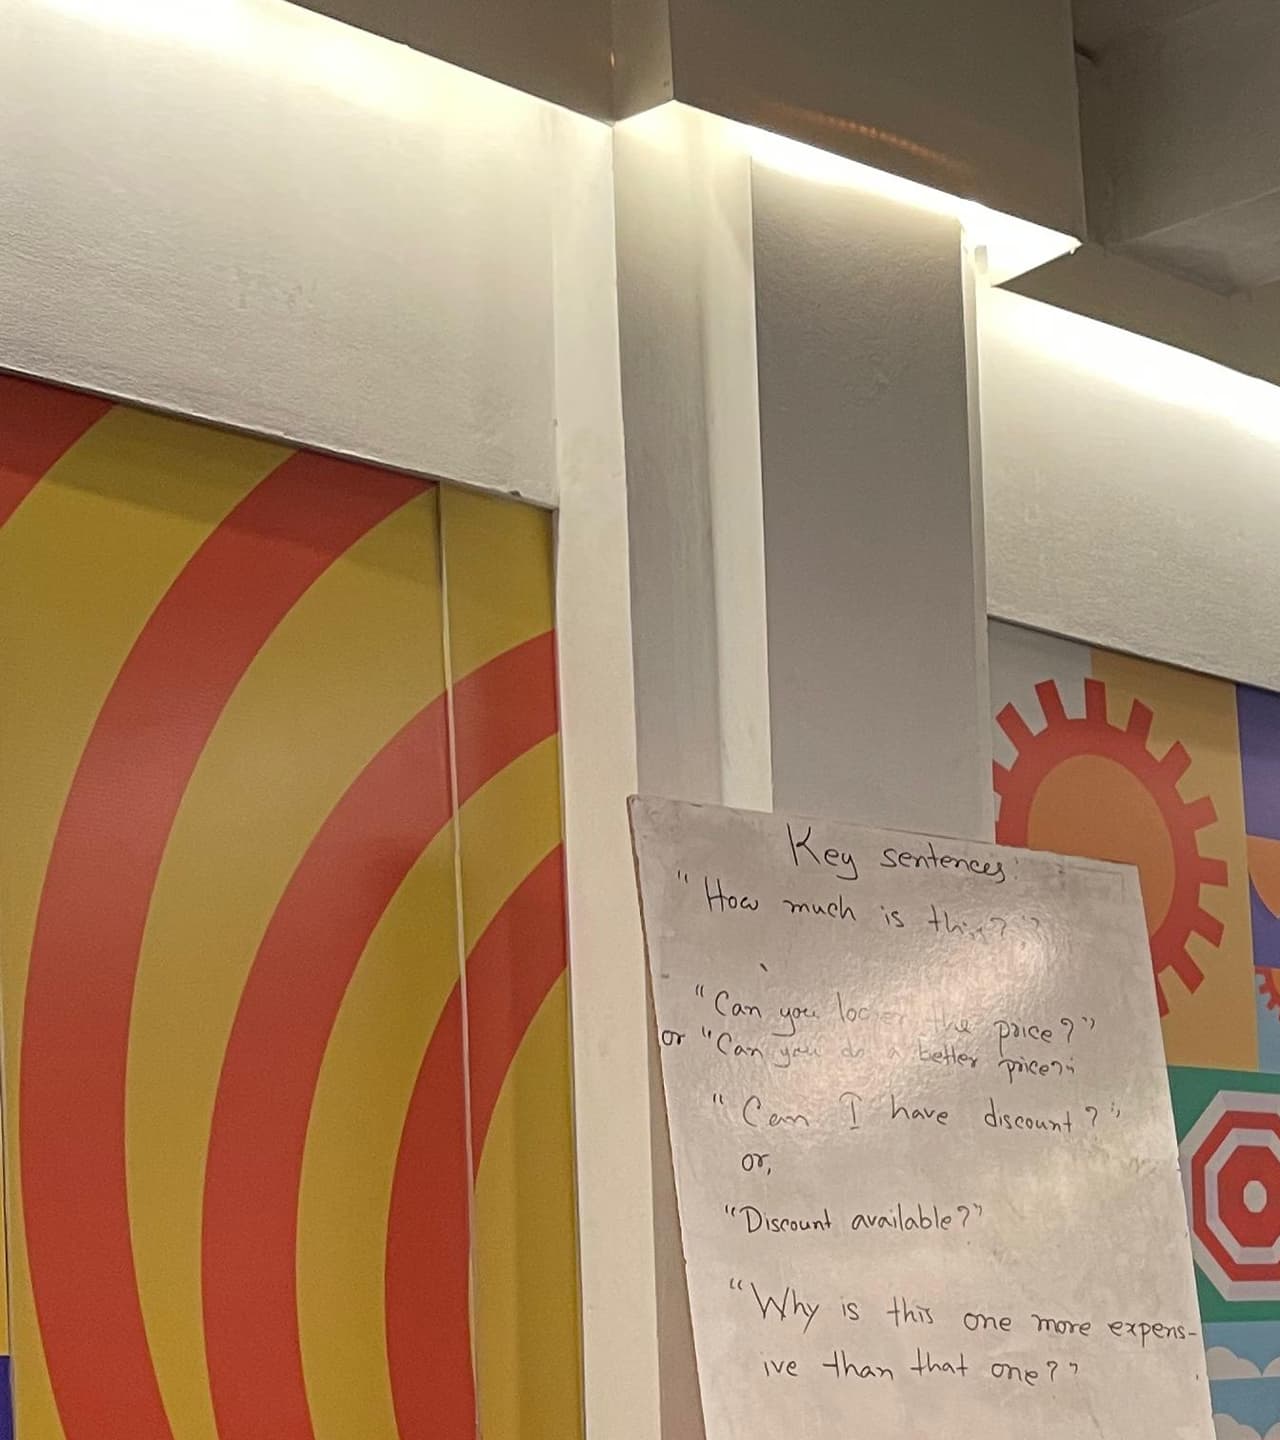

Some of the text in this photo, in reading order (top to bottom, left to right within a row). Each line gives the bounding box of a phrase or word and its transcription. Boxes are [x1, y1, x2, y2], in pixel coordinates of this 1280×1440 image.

[786, 823, 858, 880] Key
[784, 895, 856, 922] much
[880, 905, 904, 928] is
[772, 1005, 820, 1037] you
[661, 1030, 686, 1047] or
[774, 1044, 822, 1068] you
[918, 1037, 978, 1068] better
[839, 1091, 862, 1129] I
[891, 1094, 949, 1126] have
[841, 1297, 859, 1321] is
[887, 1295, 934, 1325] this
[964, 1312, 1012, 1334] one
[1032, 1314, 1092, 1337] more
[763, 1358, 798, 1378] ive
[822, 1350, 894, 1380] than
[910, 1347, 969, 1377] that
